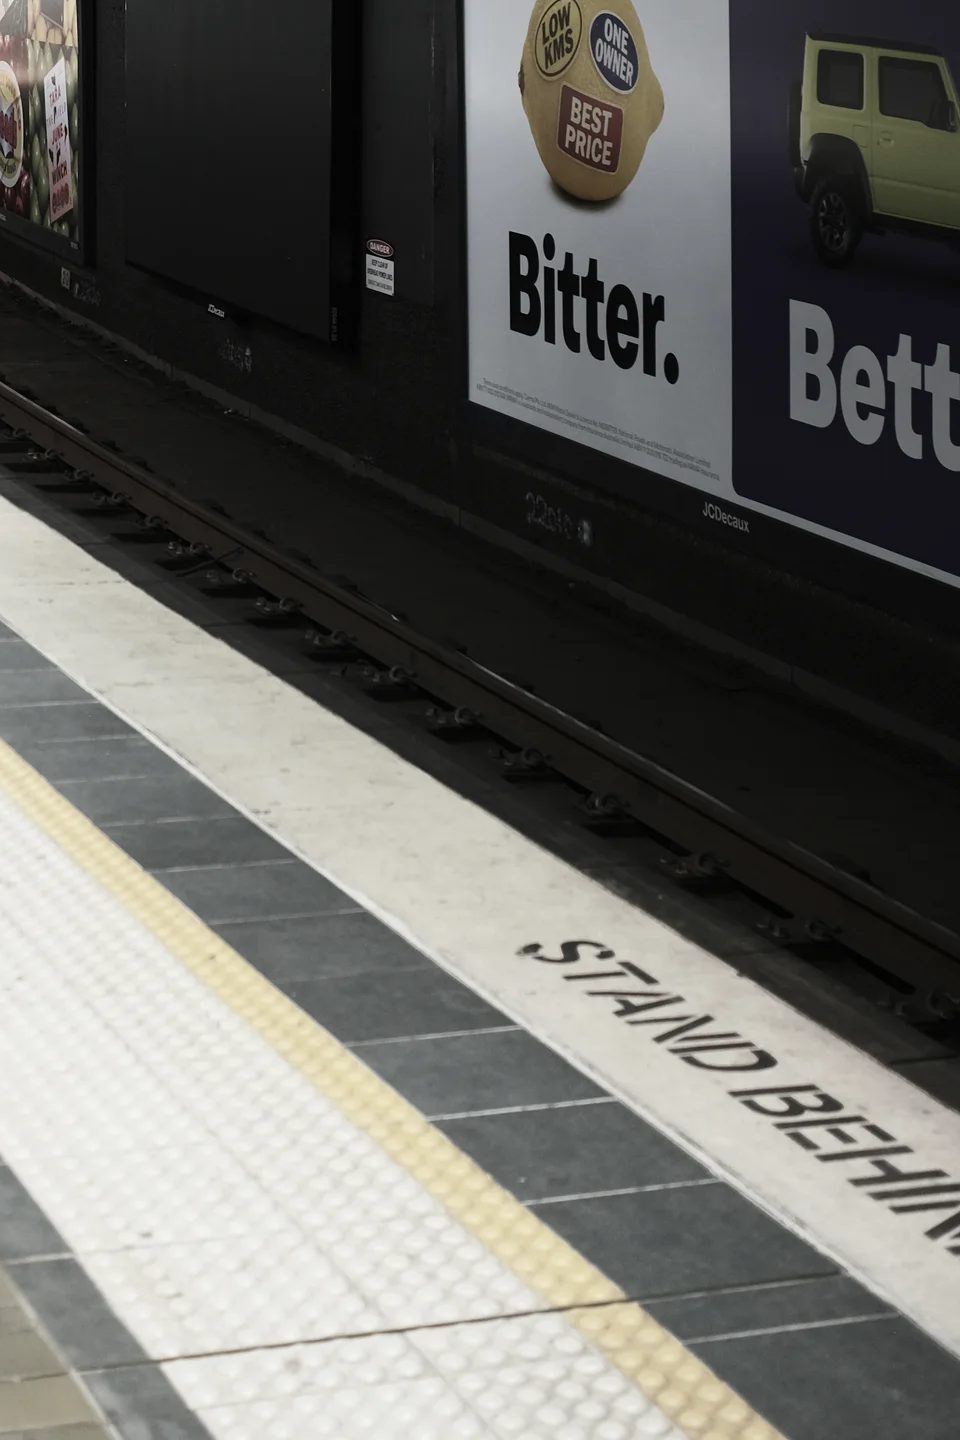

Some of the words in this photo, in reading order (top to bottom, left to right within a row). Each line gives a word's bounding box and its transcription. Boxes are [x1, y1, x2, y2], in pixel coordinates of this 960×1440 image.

[541, 1, 572, 46] LOW
[603, 18, 629, 55] ONE
[544, 28, 574, 70] KMS
[594, 38, 634, 88] OWNER
[570, 96, 613, 137] BEST
[564, 123, 614, 166] PRICE
[369, 241, 390, 255] DANGER
[509, 230, 679, 385] Bitter.
[789, 298, 960, 472] Bett
[702, 500, 750, 534] JCDecaux
[515, 938, 779, 1074] STAND
